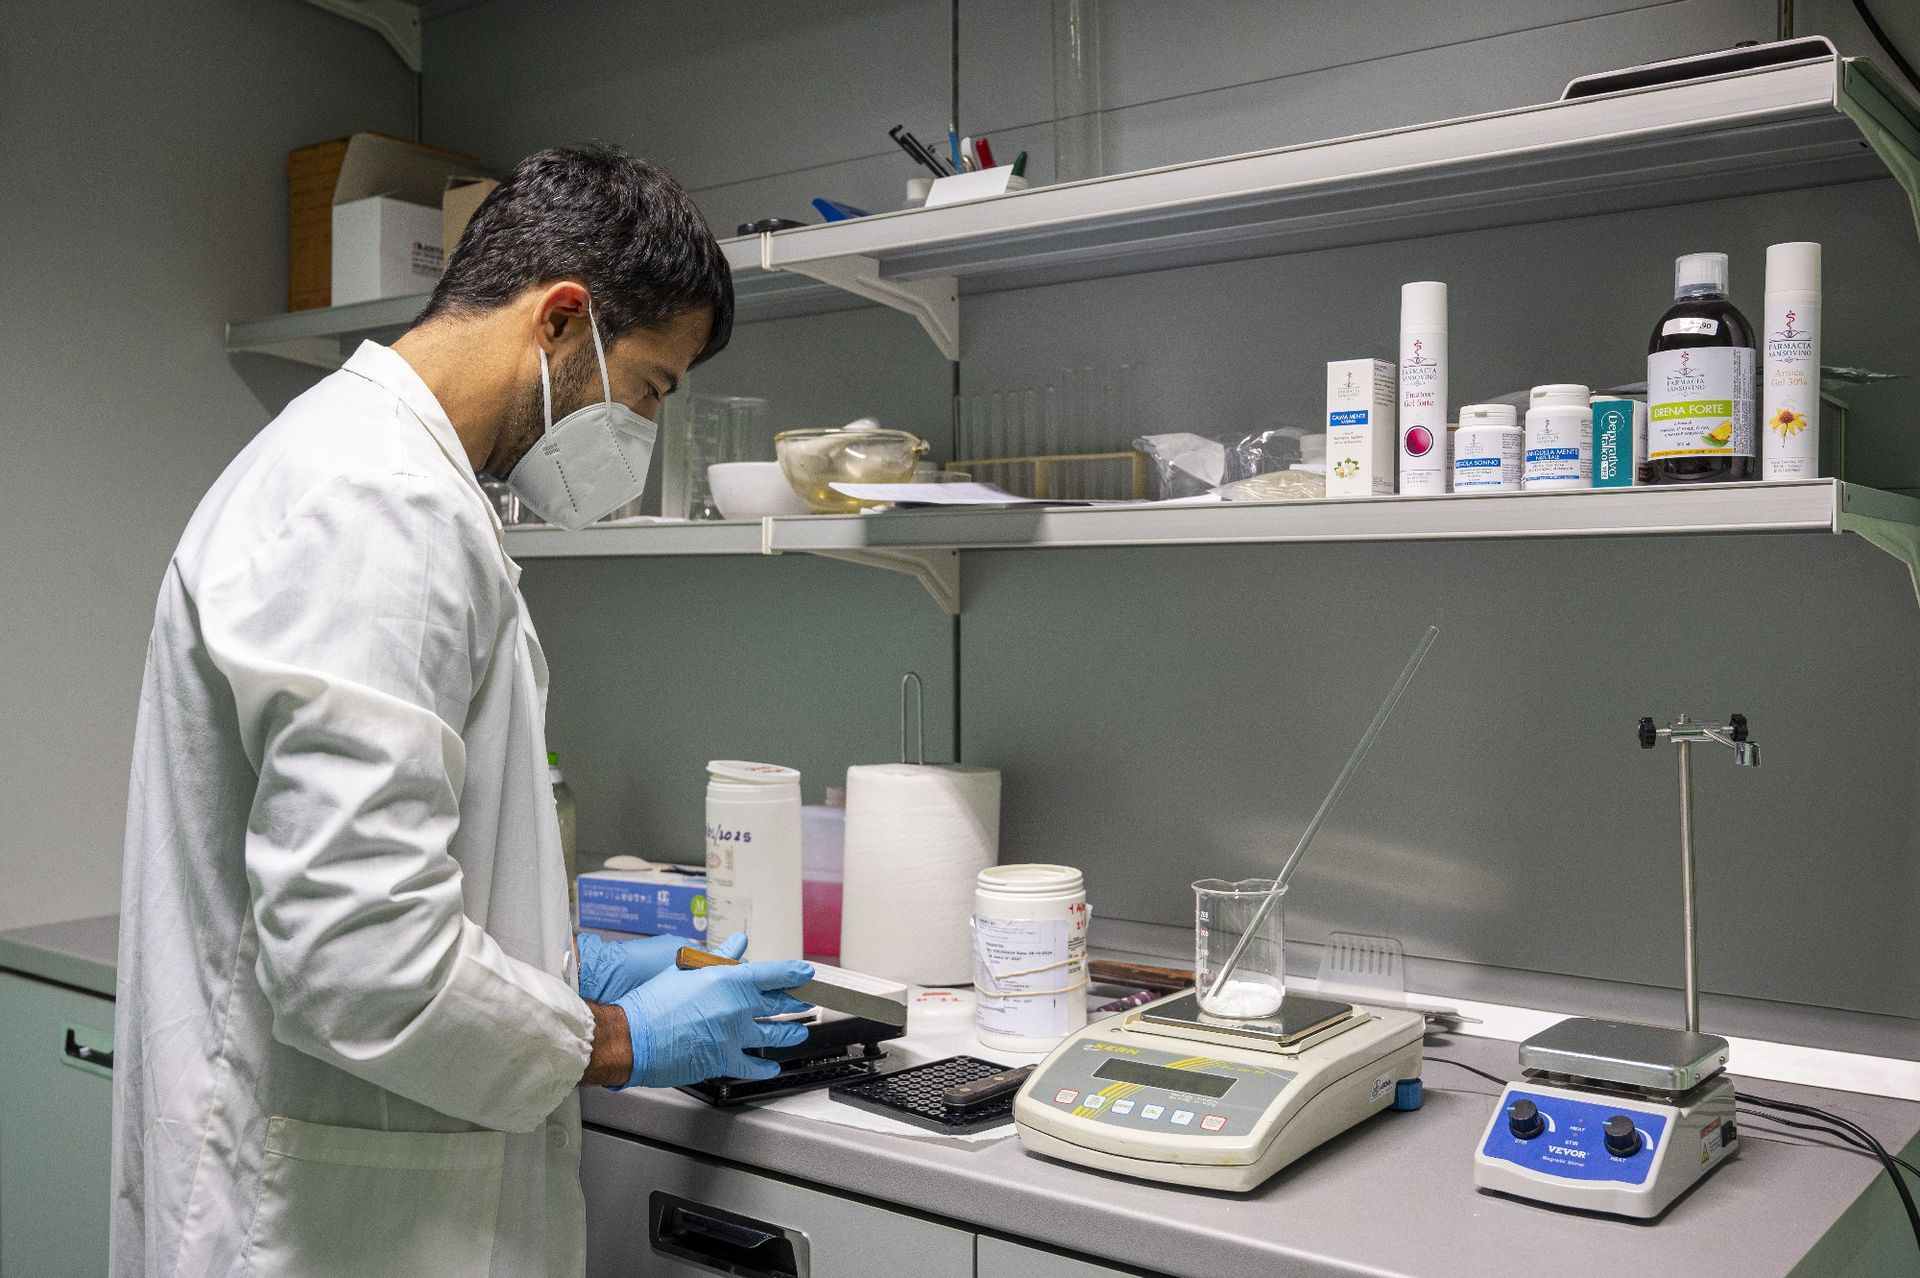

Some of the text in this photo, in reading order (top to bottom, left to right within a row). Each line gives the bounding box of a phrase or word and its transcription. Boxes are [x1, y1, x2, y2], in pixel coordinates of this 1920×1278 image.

[1768, 342, 1812, 351] FARMACIA
[1768, 350, 1812, 358] SANSOVINO
[1666, 378, 1705, 387] FARMACIA
[1654, 403, 1725, 419] DRENA FORTE
[1606, 415, 1619, 477] Depurativo
[1474, 459, 1499, 467] SONNO
[1094, 1043, 1140, 1056] KERN
[1569, 1125, 1585, 1133] HEAT
[1564, 1139, 1580, 1147] STIR
